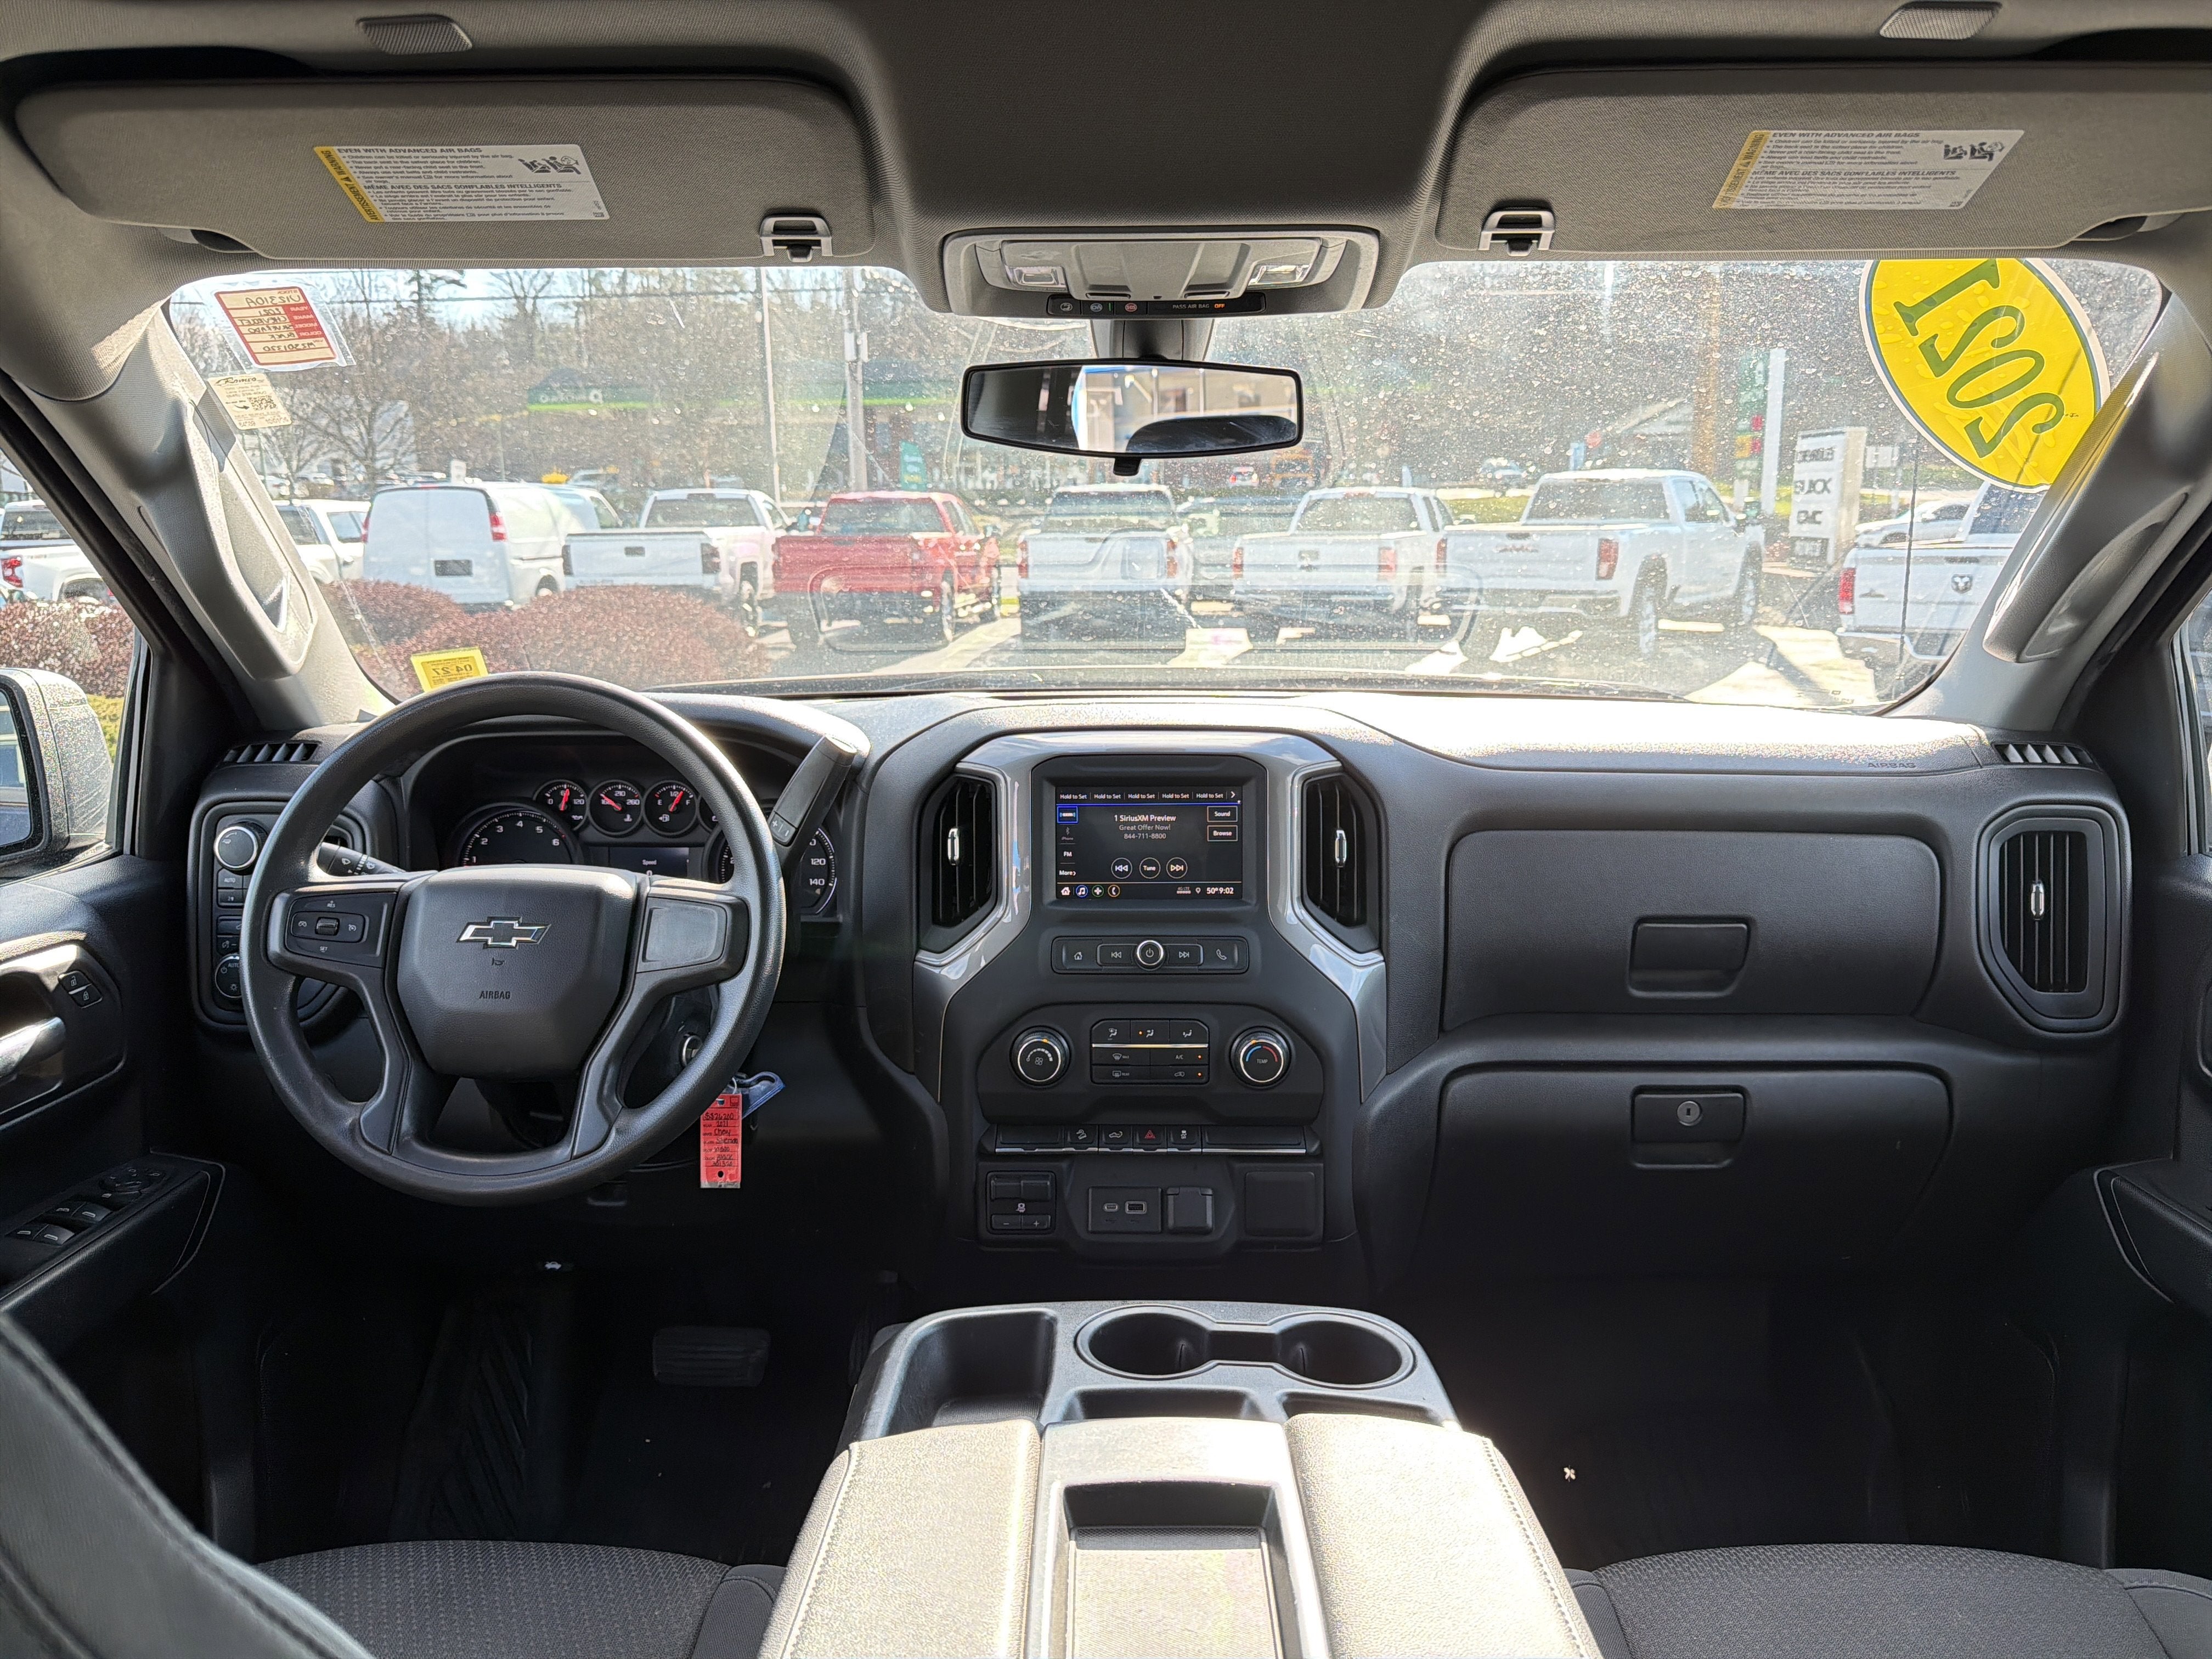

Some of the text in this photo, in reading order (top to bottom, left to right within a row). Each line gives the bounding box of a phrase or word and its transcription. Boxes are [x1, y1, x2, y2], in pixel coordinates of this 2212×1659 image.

[321, 150, 346, 176] WARNING
[345, 183, 380, 221] AVERTISSEMENT
[478, 991, 511, 1000] AIRBAG
